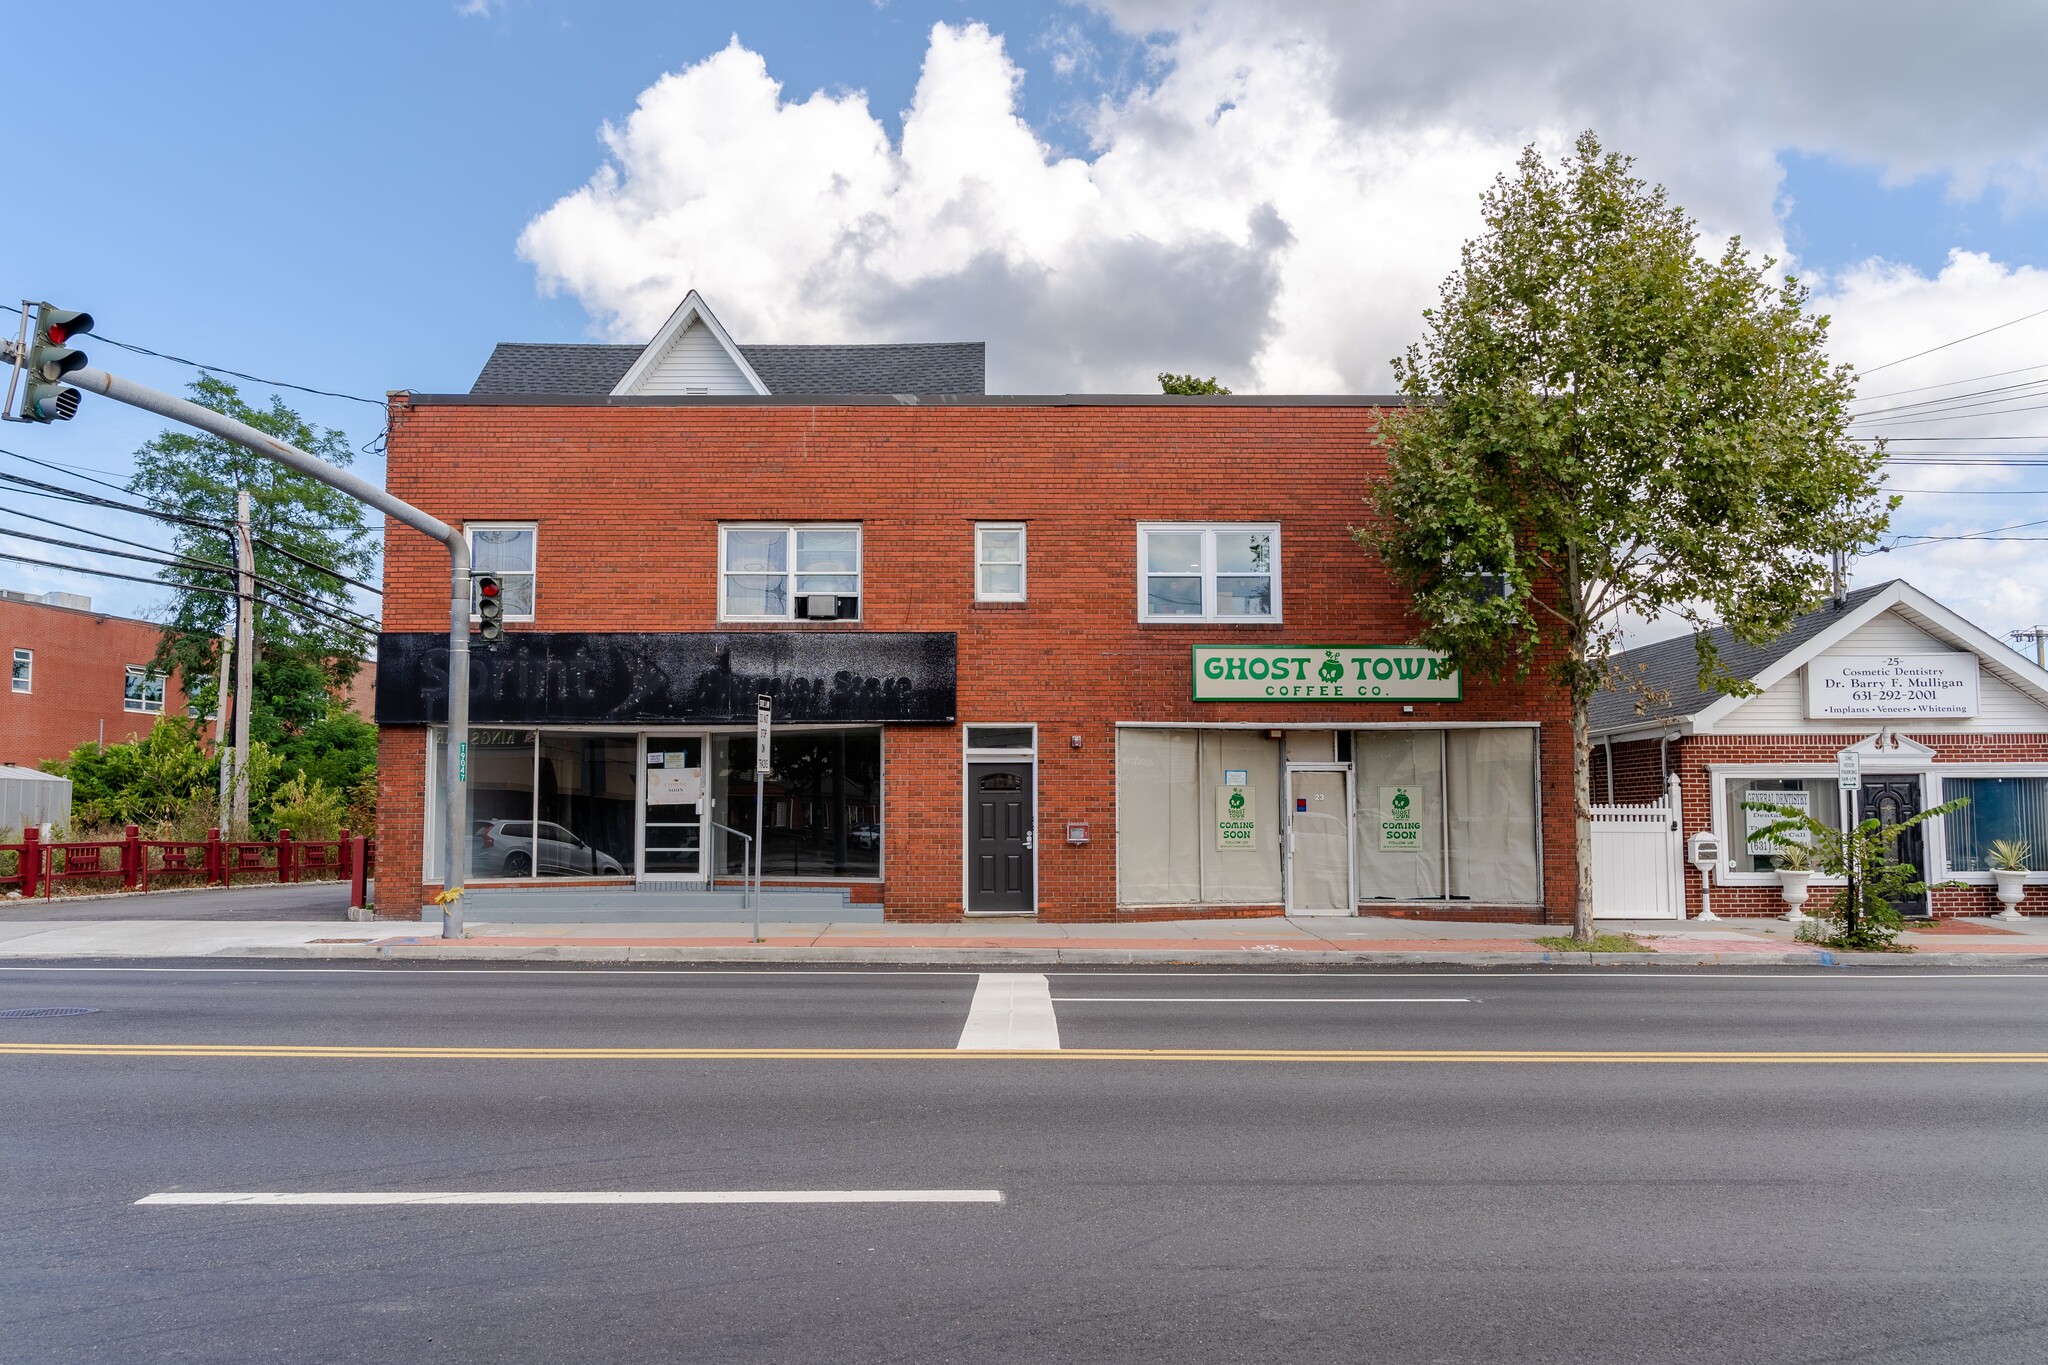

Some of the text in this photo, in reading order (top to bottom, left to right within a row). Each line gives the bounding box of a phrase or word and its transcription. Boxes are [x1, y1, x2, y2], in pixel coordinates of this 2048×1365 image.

[1203, 657, 1451, 680] GHOST TOWN
[1842, 667, 1945, 676] Cosmetic Dentistry
[1825, 678, 1964, 689] Dr. Barry F. Mulligan
[1265, 686, 1390, 696] COFFEE CO.
[1852, 690, 1937, 701] 631-292-2001
[1877, 705, 1911, 713] Veneers
[1918, 705, 1967, 713] Whitening
[1776, 793, 1808, 805] DENTISTRY
[1223, 830, 1251, 839] SOON
[1386, 831, 1416, 840] SOON
[1750, 840, 1772, 854] (631)
